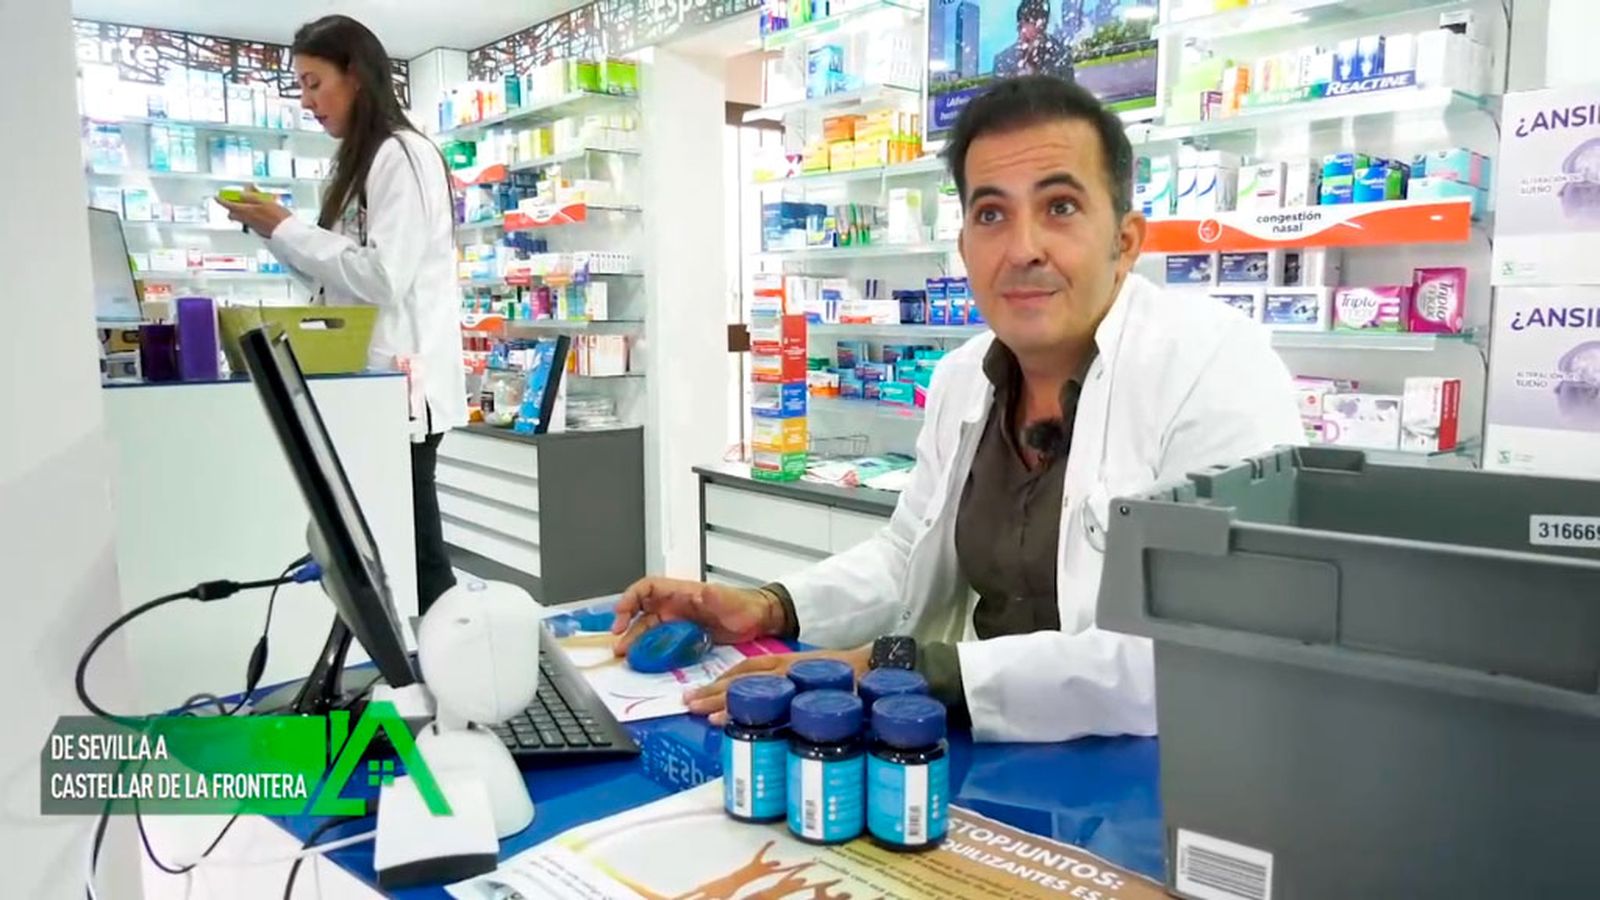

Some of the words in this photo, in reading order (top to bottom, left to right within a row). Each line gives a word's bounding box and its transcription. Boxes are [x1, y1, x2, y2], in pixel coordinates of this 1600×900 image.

[1325, 74, 1410, 95] REACTINE
[1256, 211, 1322, 224] congestión
[1272, 223, 1304, 233] nasal
